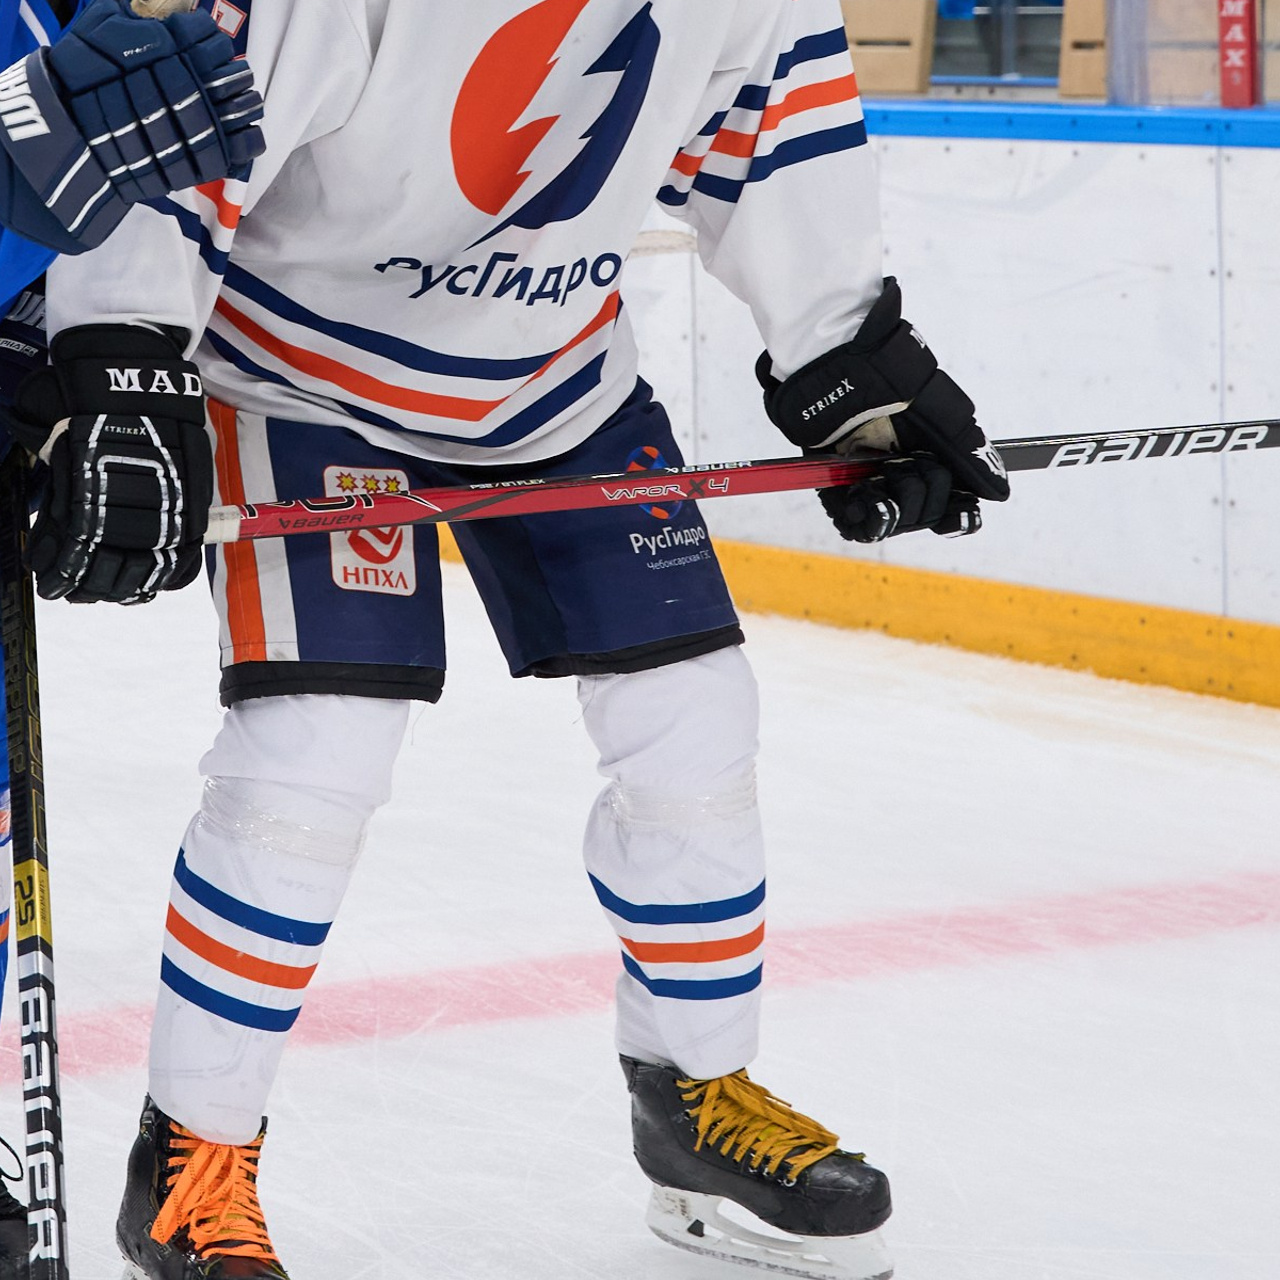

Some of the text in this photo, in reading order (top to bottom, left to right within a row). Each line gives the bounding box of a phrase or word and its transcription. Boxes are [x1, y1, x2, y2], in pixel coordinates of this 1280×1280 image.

[373, 251, 623, 307] РусГидро
[105, 368, 203, 397] MAD
[801, 377, 856, 421] STRIKEX
[104, 425, 148, 436] STRIKEX
[1046, 424, 1269, 469] BAUER
[600, 484, 689, 500] VAPOR
[291, 513, 365, 529] BAUER
[628, 525, 706, 556] РусГидро
[342, 565, 409, 590] НПХЛ
[19, 985, 60, 1264] BAUER
